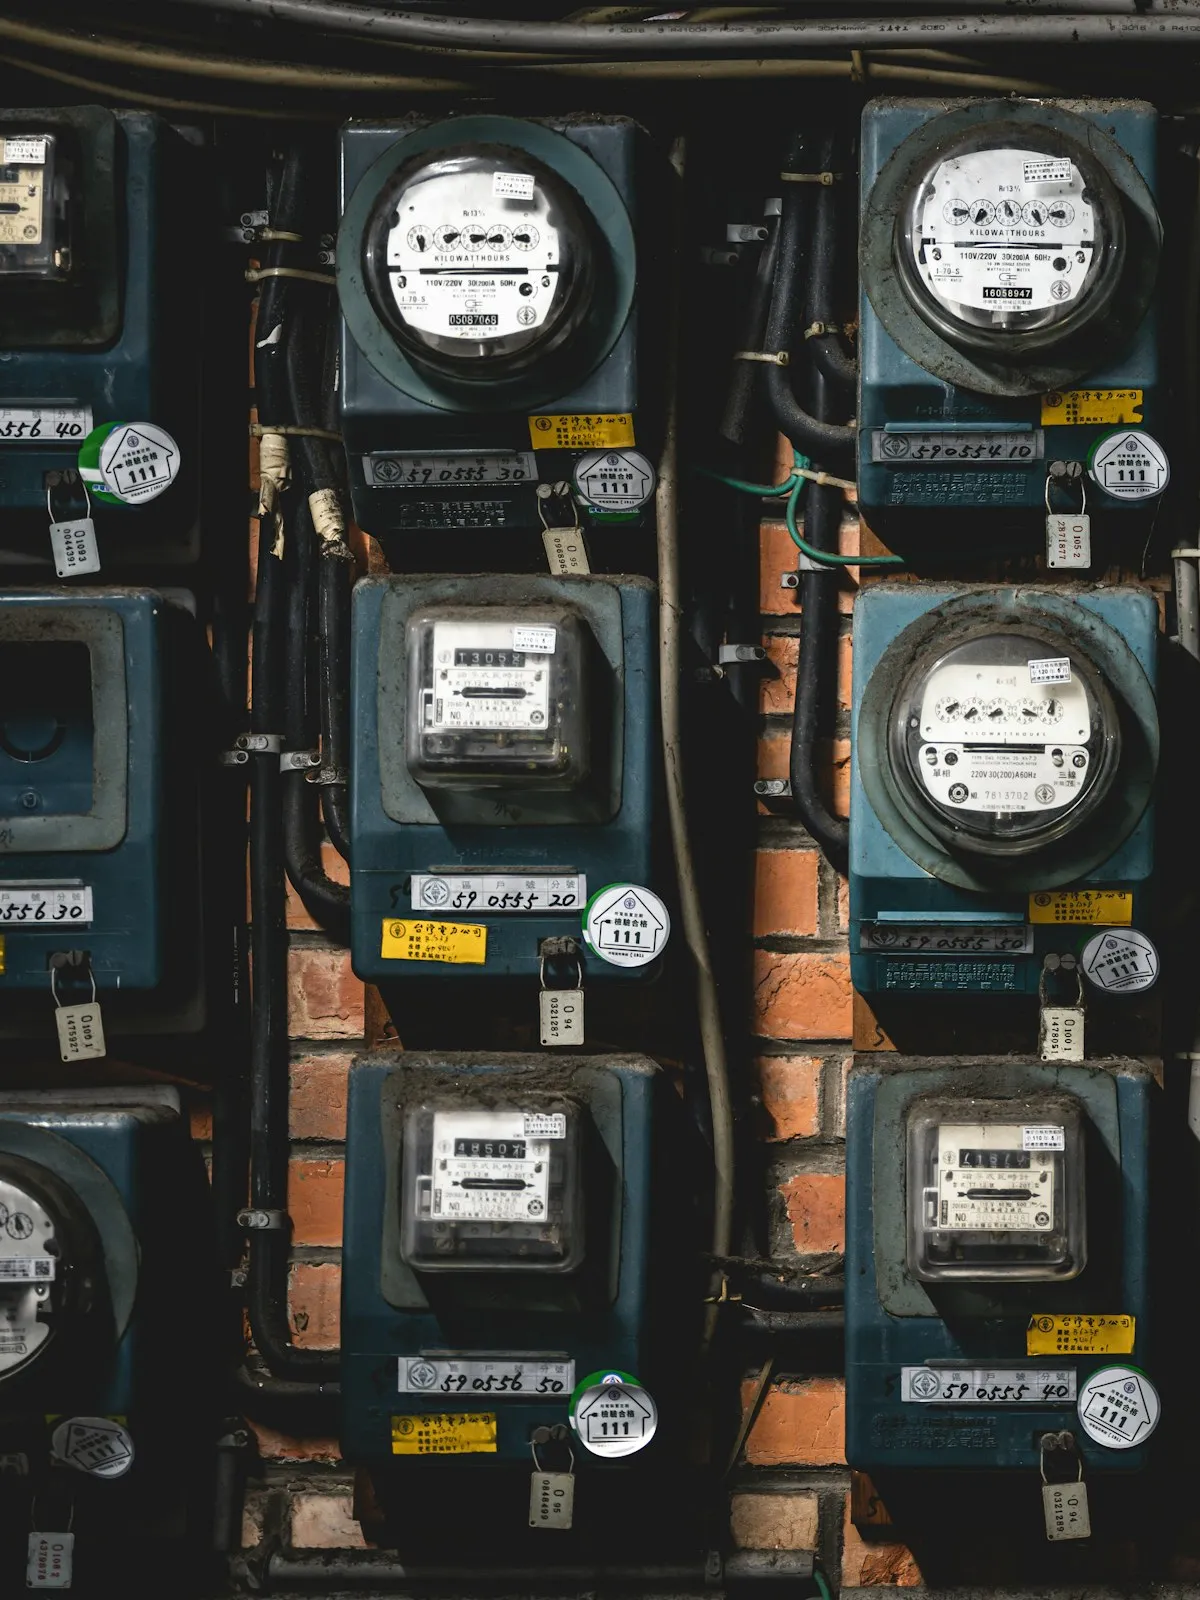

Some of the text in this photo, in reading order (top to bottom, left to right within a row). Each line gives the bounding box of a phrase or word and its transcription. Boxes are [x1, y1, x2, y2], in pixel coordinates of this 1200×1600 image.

[969, 229, 1045, 237] KILOWATTHOURS
[960, 252, 997, 260] 110V/220V
[425, 279, 463, 287] 110V/220V
[983, 288, 1032, 298] 16058947
[449, 314, 498, 325] 05087068
[0, 419, 82, 438] 556 40
[911, 444, 1032, 459] 59 0554 10
[124, 453, 158, 468] 檢驗合格
[1117, 458, 1151, 467] 檢驗合格
[128, 465, 157, 484] 111
[406, 468, 526, 482] 59 0555 30
[600, 472, 633, 481] 檢驗合格
[1118, 469, 1145, 481] 111
[600, 482, 629, 494] 111
[63, 528, 76, 567] 0044391
[1057, 520, 1066, 560] 2871877
[452, 891, 576, 909] 59 0555 20
[0, 901, 83, 920] 556 30
[414, 923, 481, 938] 台灣電力公司
[614, 918, 648, 929] 檢驗合格
[613, 929, 641, 944] 111
[902, 936, 1023, 950] 59 0555 50
[1105, 949, 1138, 966] 檢驗合格
[1110, 960, 1139, 978] 111
[550, 997, 559, 1037] 0321287
[66, 1015, 79, 1053] 1475927
[1051, 1017, 1059, 1054] 1478051
[1062, 1316, 1129, 1328] 台灣電力公司
[440, 1372, 564, 1393] 59 0556 50
[942, 1384, 1069, 1400] 59 0555 40
[1107, 1395, 1139, 1417] 檢驗合格
[601, 1409, 635, 1419] 檢驗合格
[1100, 1405, 1127, 1428] 111
[601, 1422, 629, 1435] 111
[88, 1444, 115, 1461] 111
[1053, 1491, 1065, 1532] 0321289
